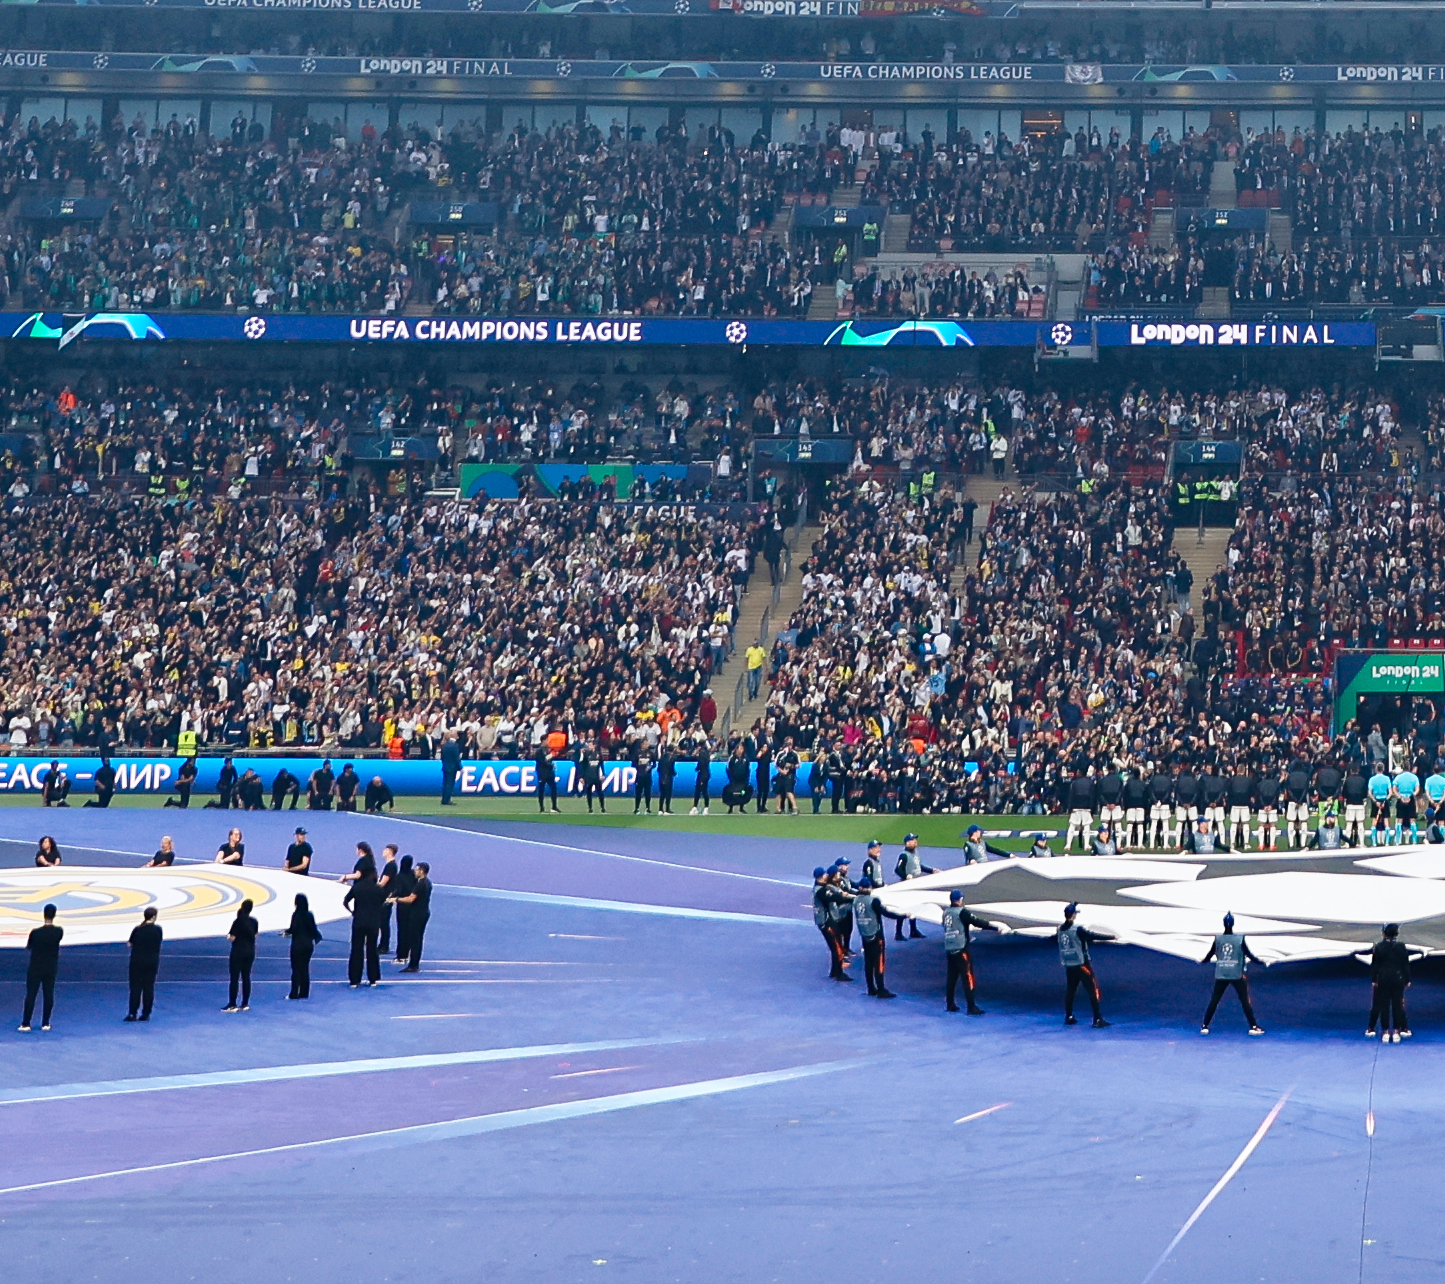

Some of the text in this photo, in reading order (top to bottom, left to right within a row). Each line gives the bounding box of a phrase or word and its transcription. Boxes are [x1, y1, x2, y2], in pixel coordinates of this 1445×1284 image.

[799, 0, 821, 15] 24
[427, 58, 448, 75] 24
[453, 60, 512, 76] FINAL
[820, 65, 1032, 81] UEFA CHAMPIONS LEAGUE
[1402, 66, 1423, 82] 24
[350, 319, 642, 341] UEFA CHAMPIONS LEAGUE
[1216, 323, 1248, 345] 24
[1255, 324, 1335, 344] FINAL
[1422, 665, 1439, 678] 24
[459, 765, 536, 793] EACE
